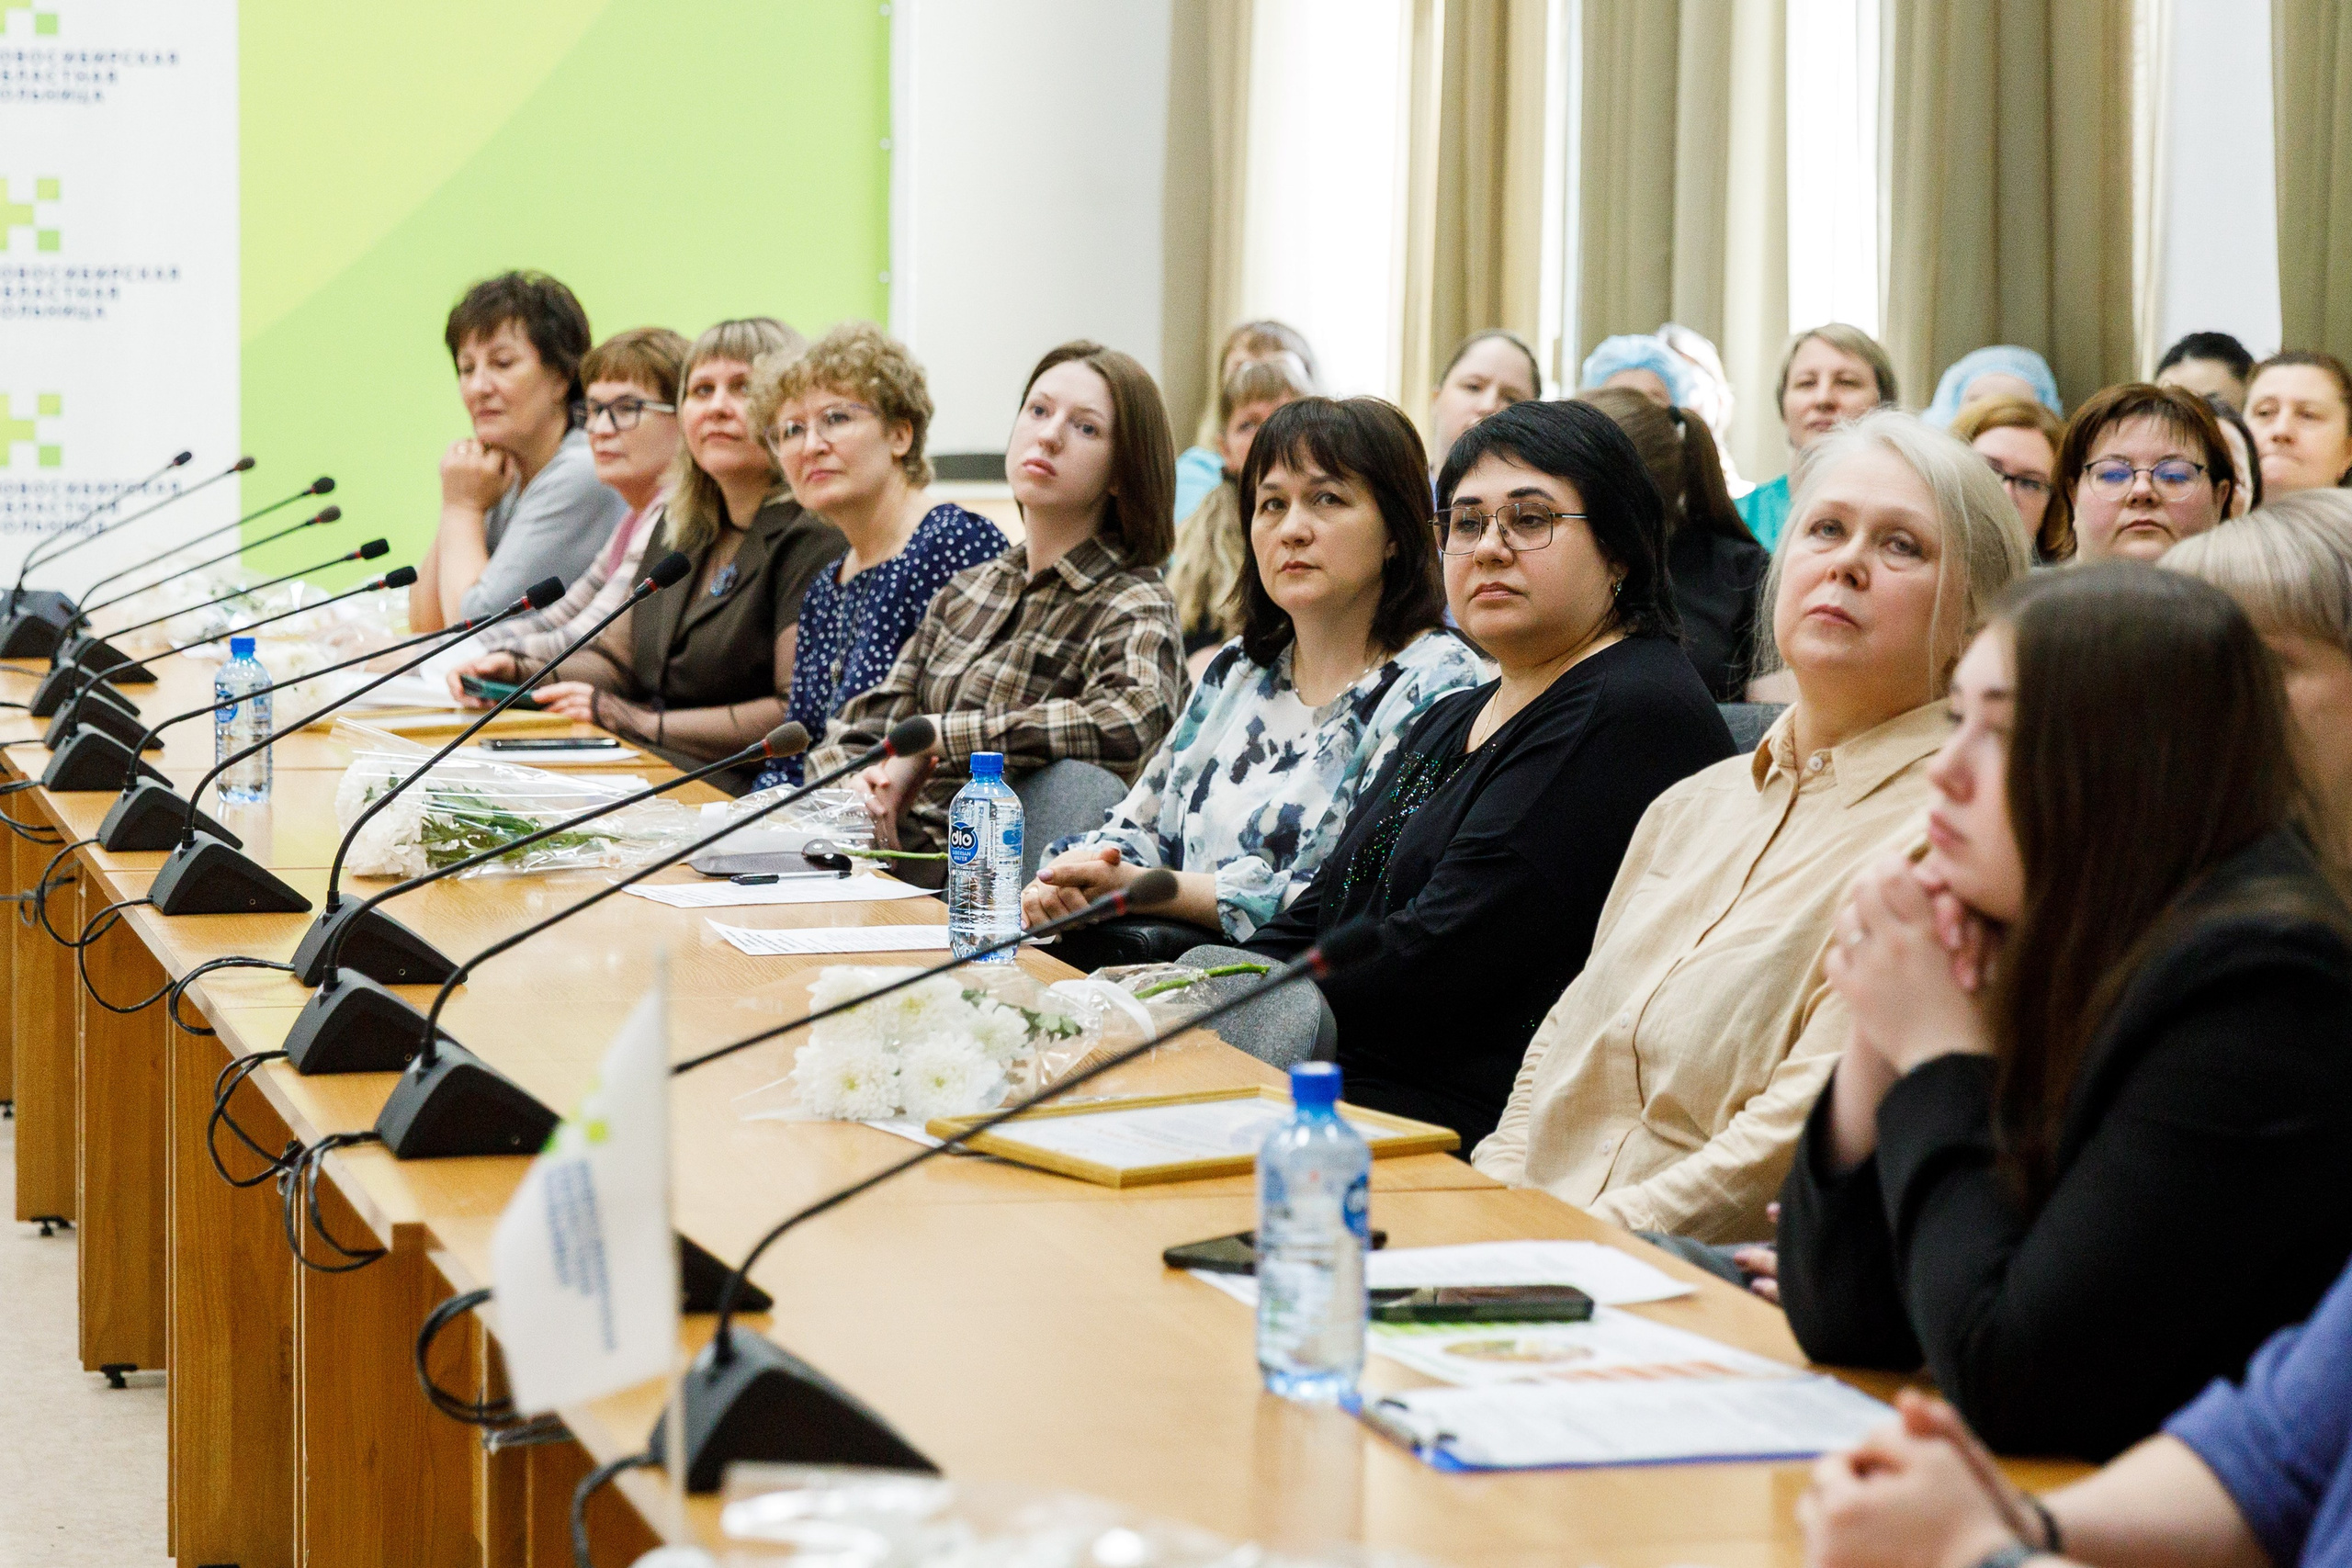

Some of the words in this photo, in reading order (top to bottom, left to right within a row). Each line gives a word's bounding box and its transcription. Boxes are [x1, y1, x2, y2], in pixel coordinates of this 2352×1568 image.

[0, 49, 178, 65] ОВОСИБИРСКАЯ
[0, 67, 118, 84] БЛАСТНАЯ
[0, 87, 105, 103] ОЛЬНИЦА
[0, 265, 180, 281] ОВОСИБИРСКАЯ
[2, 284, 119, 300] БЛАСТНАЯ
[0, 303, 107, 319] ОЛЬНИЦА
